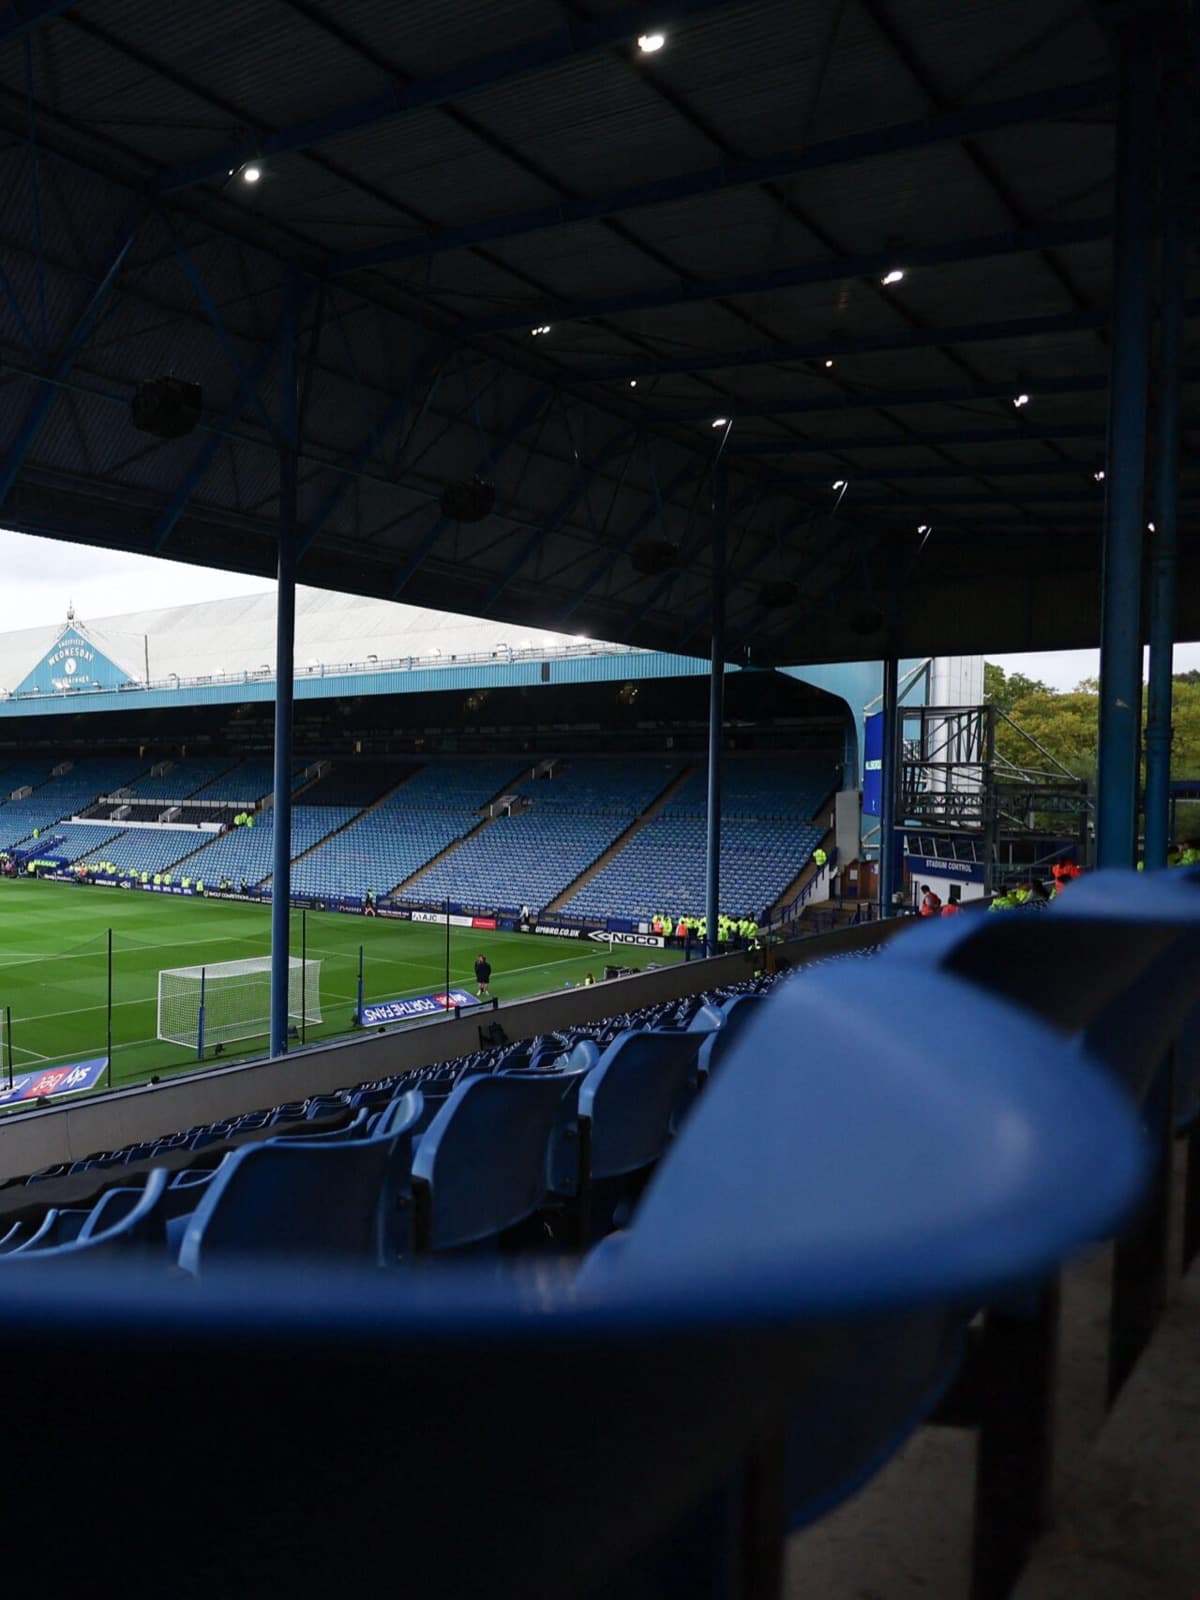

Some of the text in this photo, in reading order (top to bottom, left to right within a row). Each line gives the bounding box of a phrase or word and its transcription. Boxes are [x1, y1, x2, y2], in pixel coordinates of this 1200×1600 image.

[49, 647, 93, 666] WEDNESDAY
[926, 859, 972, 872] STADIUM CONTROL
[535, 925, 580, 938] UMBRO.CO.UK
[612, 933, 659, 946] NOCO
